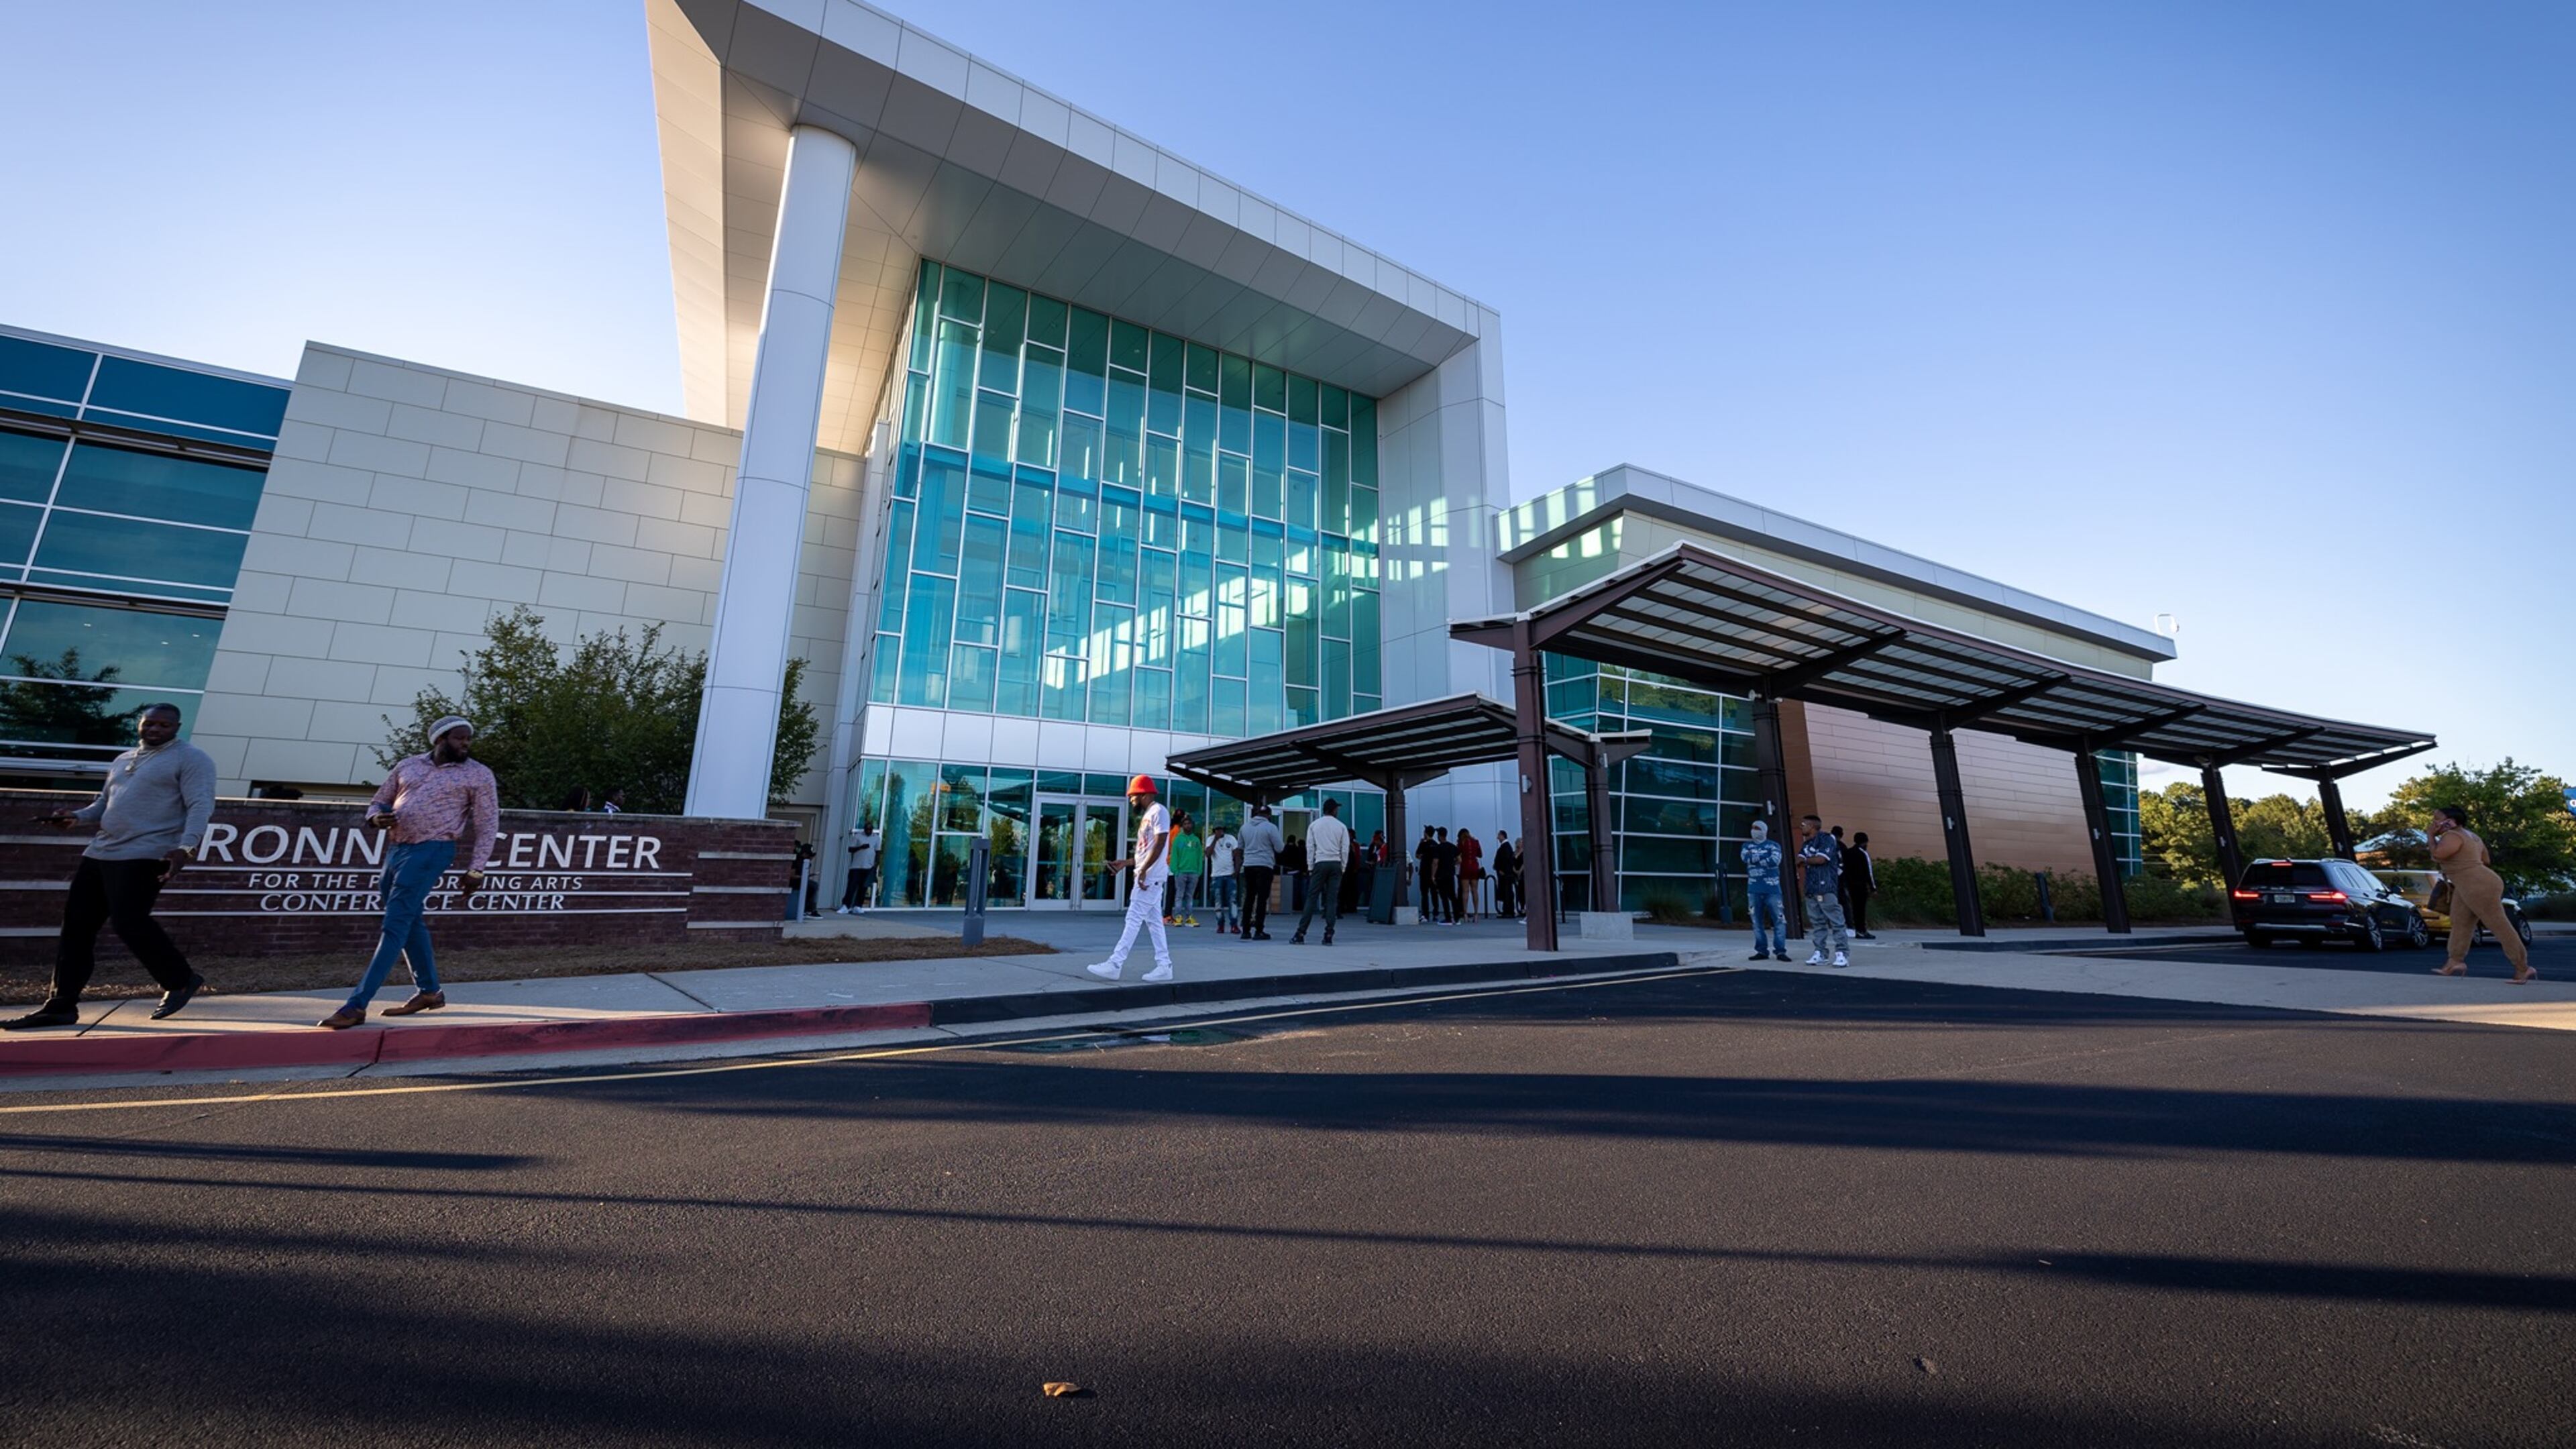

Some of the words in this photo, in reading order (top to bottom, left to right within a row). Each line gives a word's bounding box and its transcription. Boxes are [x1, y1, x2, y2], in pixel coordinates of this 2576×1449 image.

[197, 823, 453, 867] RONN
[248, 873, 299, 888] FOR
[312, 874, 357, 889] THE
[368, 875, 522, 890] PORING
[530, 876, 583, 890] ARTS
[260, 894, 454, 911] CONFERCE
[468, 895, 565, 910] CENTER
